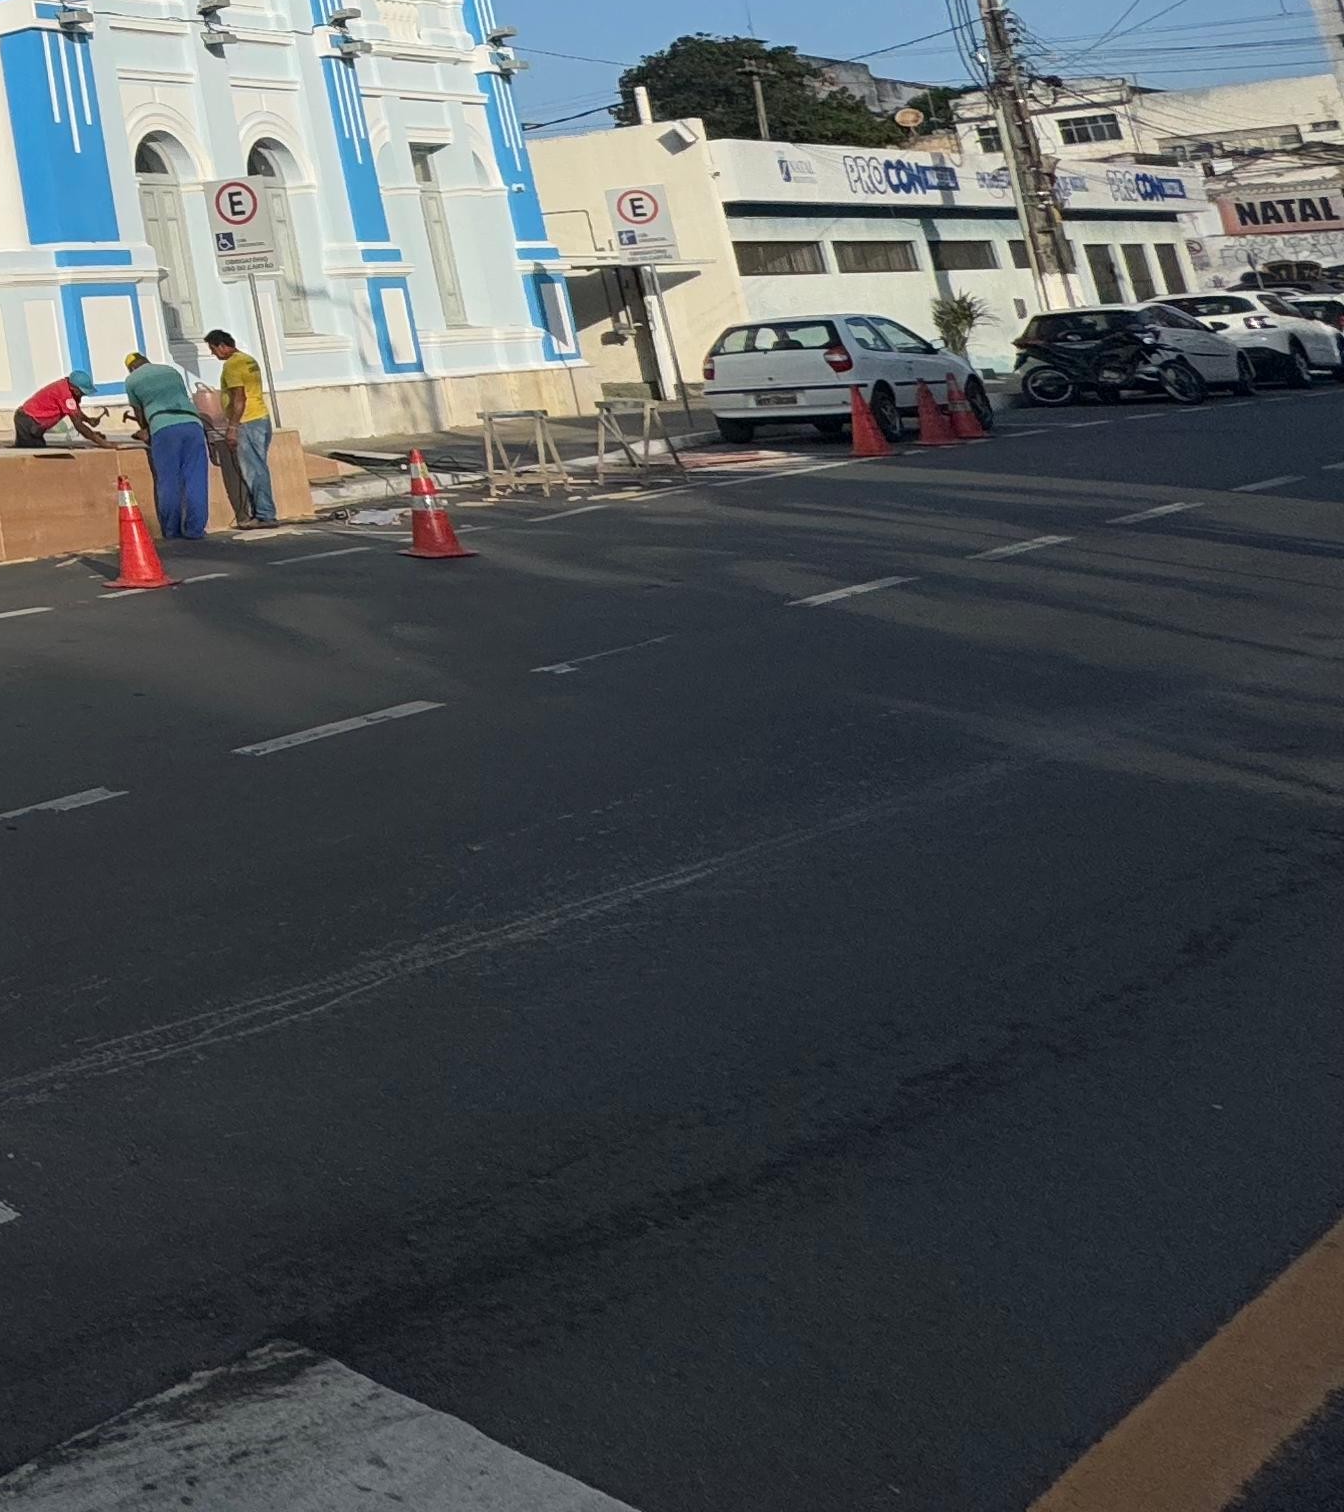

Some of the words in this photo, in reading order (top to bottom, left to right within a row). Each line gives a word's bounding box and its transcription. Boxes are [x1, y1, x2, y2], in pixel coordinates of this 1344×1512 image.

[227, 191, 246, 216] E
[628, 197, 648, 218] E
[1234, 196, 1341, 226] NATAL
